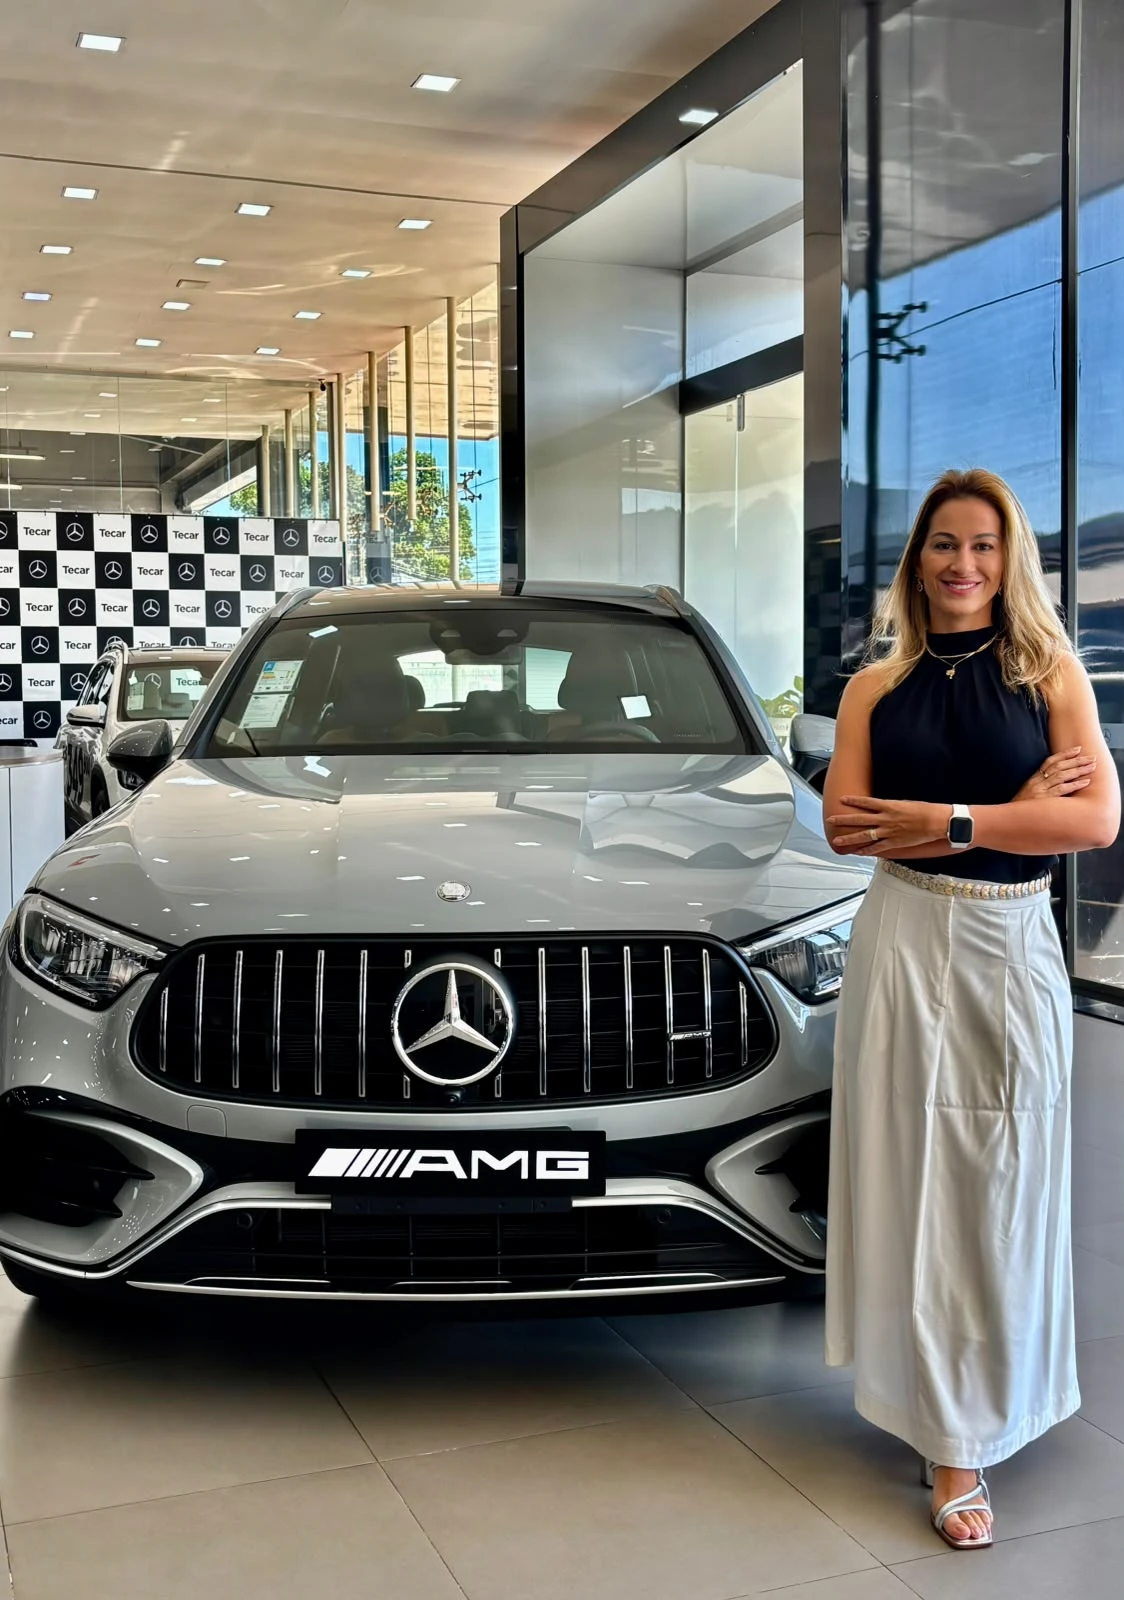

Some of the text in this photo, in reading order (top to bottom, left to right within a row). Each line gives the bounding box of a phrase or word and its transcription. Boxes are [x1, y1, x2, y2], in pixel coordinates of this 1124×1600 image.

[23, 526, 52, 536] Tecar
[99, 528, 127, 538] Tecar
[172, 530, 200, 540] Tecar
[243, 532, 270, 542] Tecar
[313, 534, 338, 543] Tecar
[0, 566, 14, 574] car
[62, 565, 90, 575] Tecar
[137, 567, 164, 576] Tecar
[210, 568, 236, 577] Tecar
[279, 569, 305, 578] Tecar
[25, 602, 54, 612] Tecar
[101, 603, 128, 613] Tecar
[174, 604, 201, 613] Tecar
[0, 642, 16, 650] car
[64, 640, 92, 650] Tecar
[27, 678, 55, 687] Tecar
[0, 717, 19, 725] car
